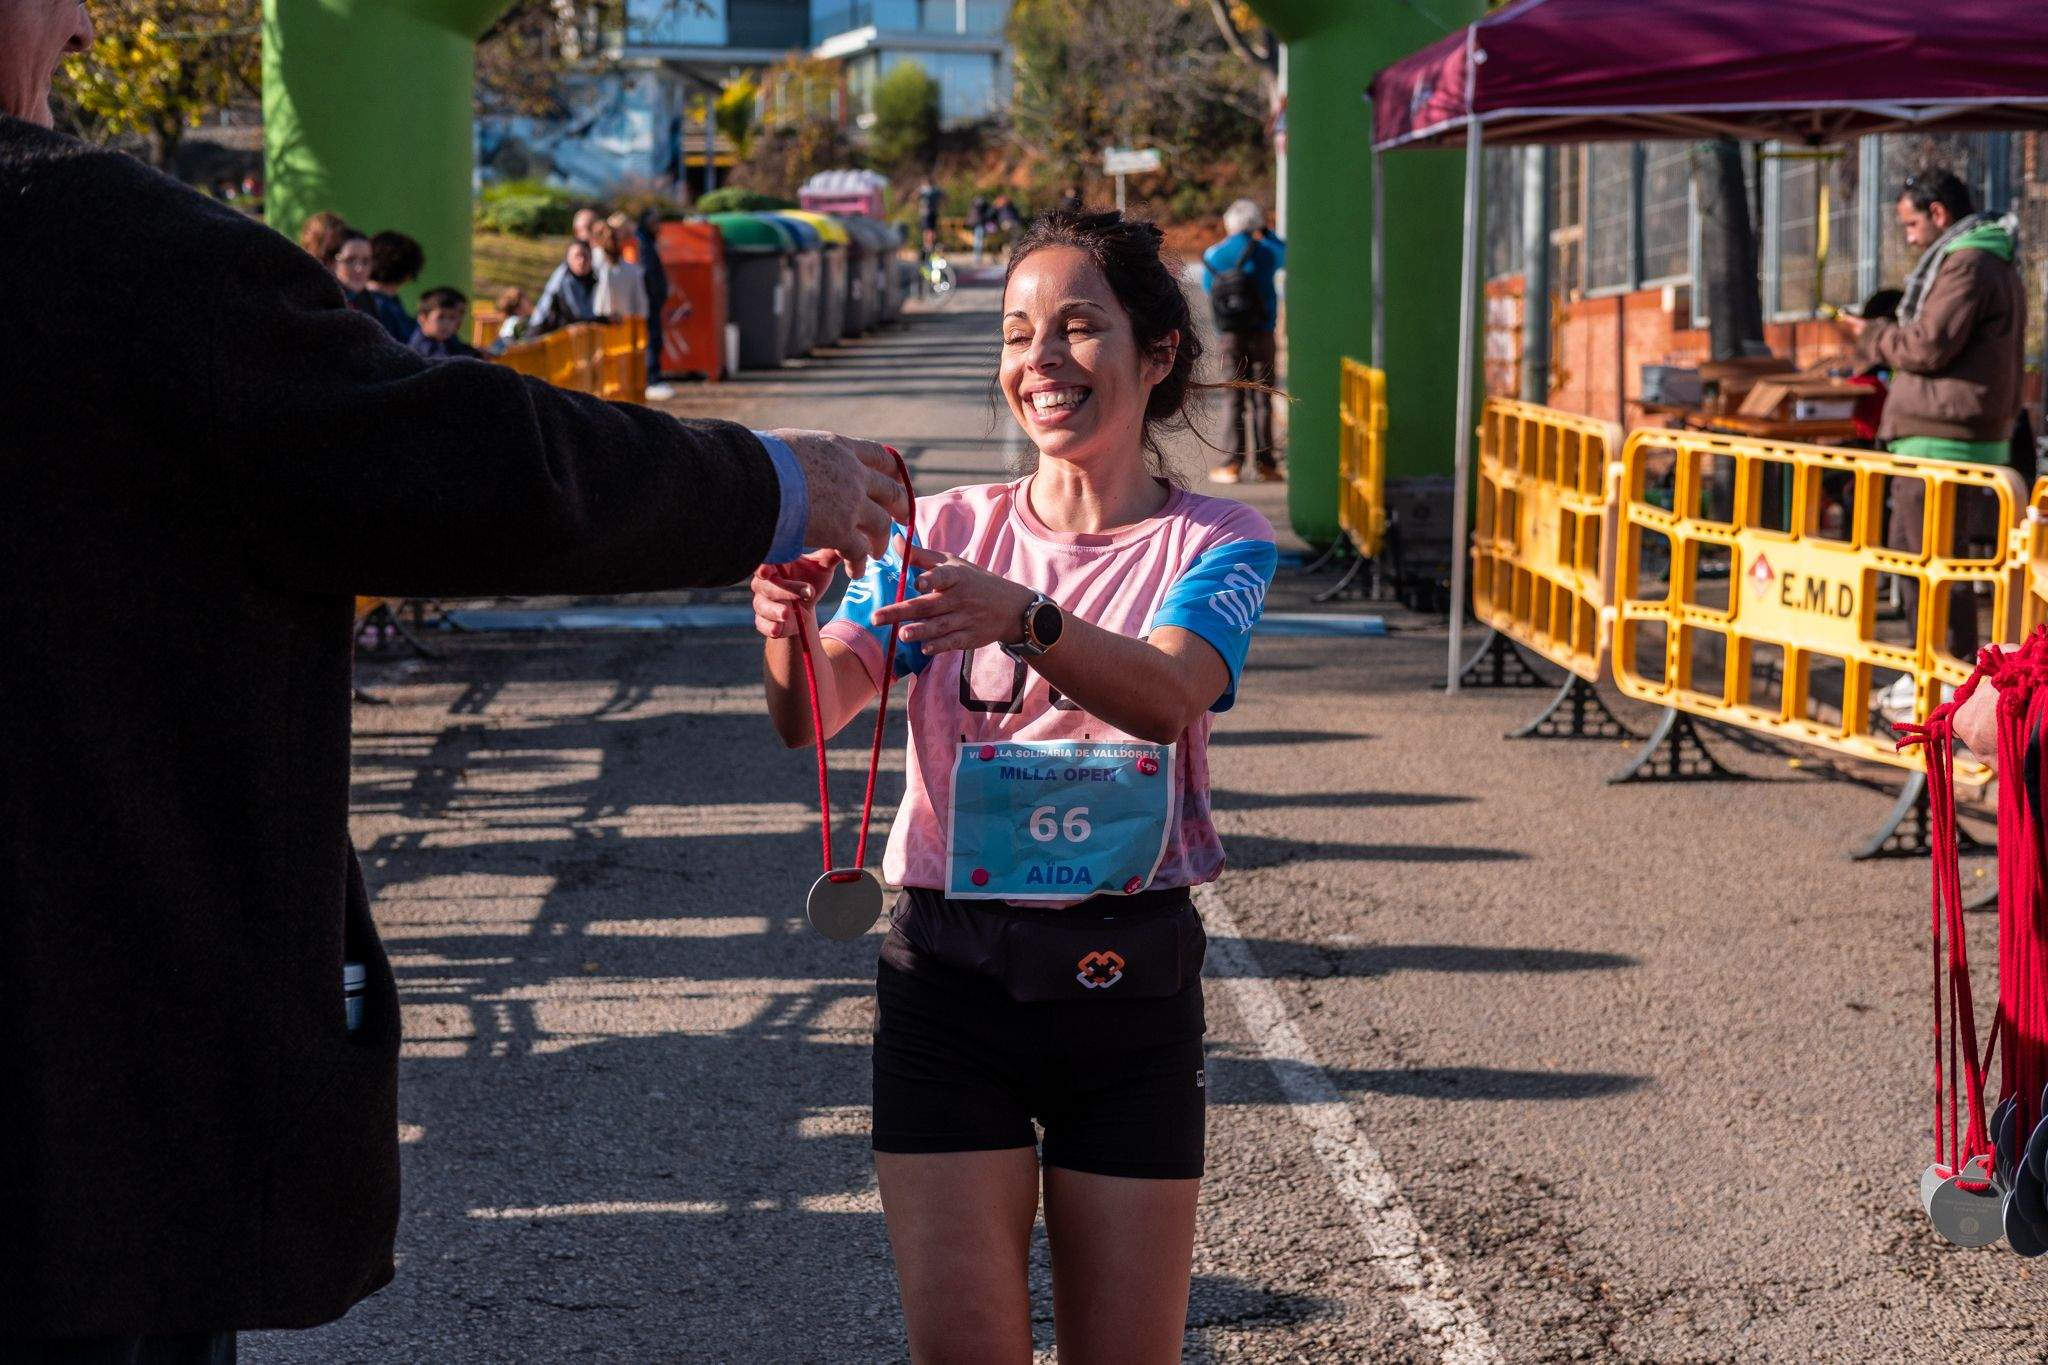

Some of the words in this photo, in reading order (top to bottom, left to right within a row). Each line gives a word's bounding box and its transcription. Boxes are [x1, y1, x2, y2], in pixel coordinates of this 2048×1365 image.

[1781, 572, 1854, 619] E.M.D
[1076, 748, 1090, 758] DE
[1093, 749, 1160, 760] VALLDOREIX
[1001, 767, 1056, 780] MILLA
[1064, 769, 1117, 782] OPEN
[1029, 805, 1092, 842] 66
[1026, 862, 1092, 884] AÏDA
